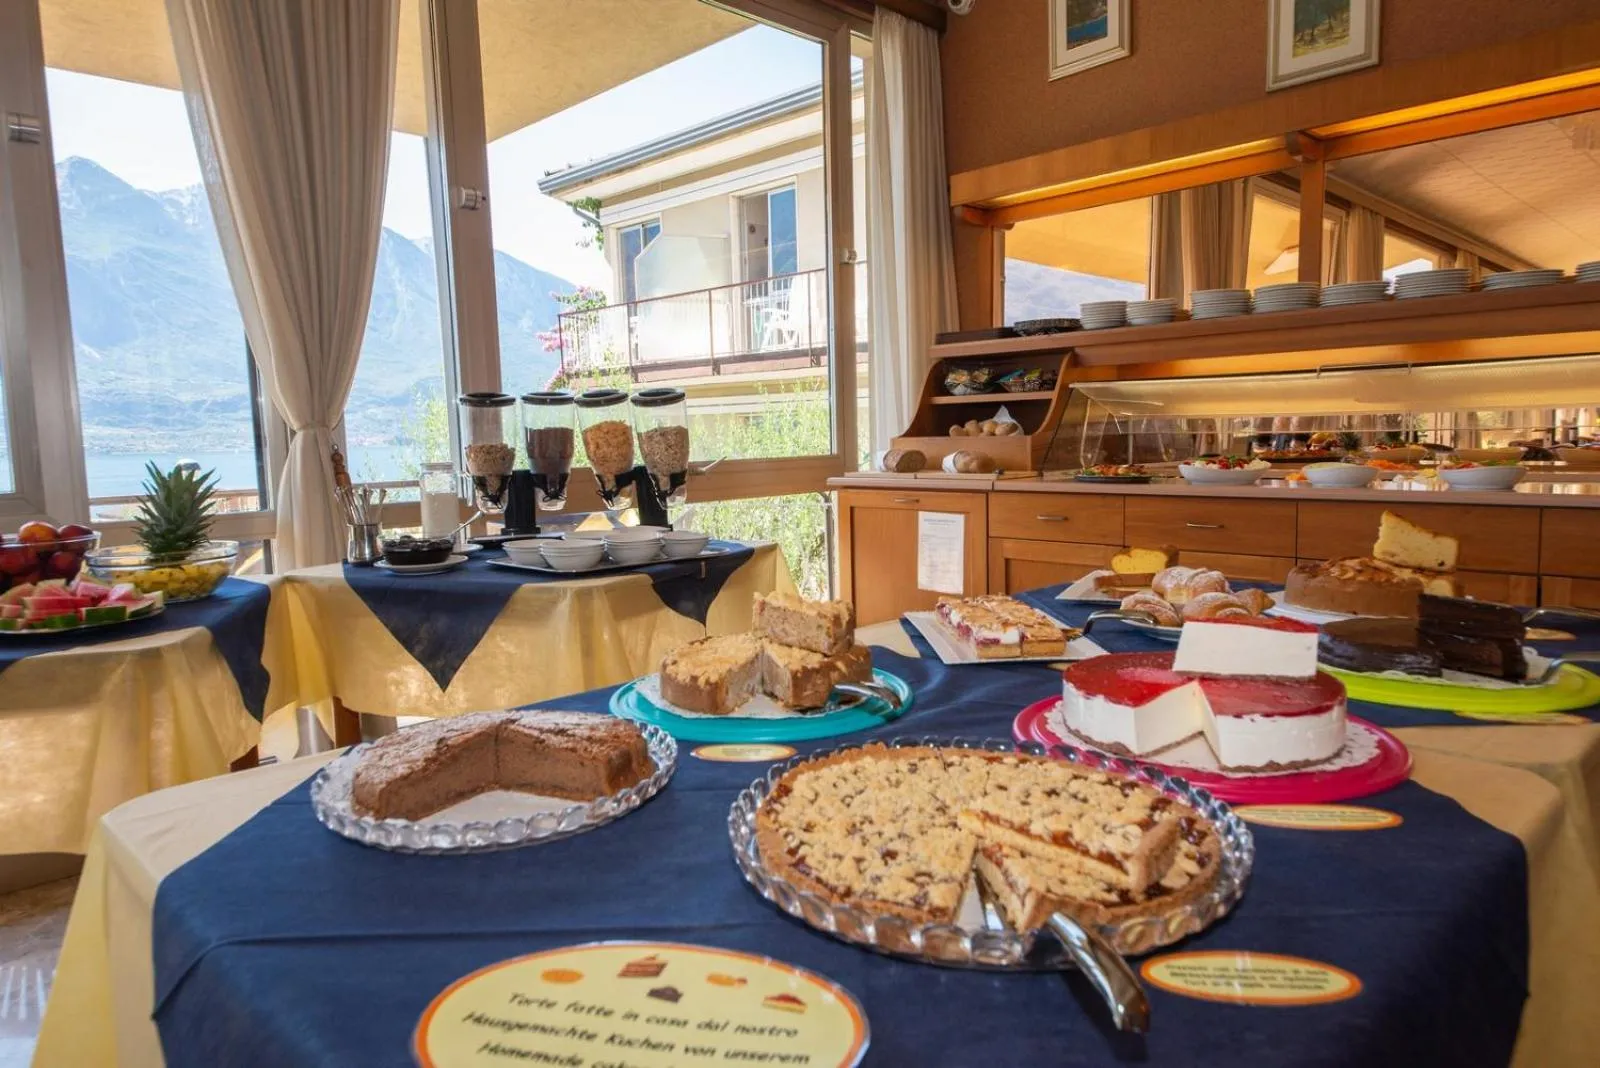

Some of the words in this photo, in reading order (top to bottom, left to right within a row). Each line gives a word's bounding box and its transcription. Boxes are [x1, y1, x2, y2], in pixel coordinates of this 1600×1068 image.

[461, 1011, 599, 1043] Hausgemachte
[604, 1032, 675, 1053] Kuchen
[683, 1044, 717, 1057] von
[723, 1048, 811, 1065] unserem
[508, 991, 558, 1009] Torte
[564, 1000, 615, 1018] fatte
[621, 1008, 640, 1022] in
[645, 1014, 689, 1028] casa
[696, 1018, 730, 1032] dal
[733, 1023, 799, 1038] nostro
[475, 1041, 585, 1067] Homemade
[590, 1059, 646, 1068] cak
